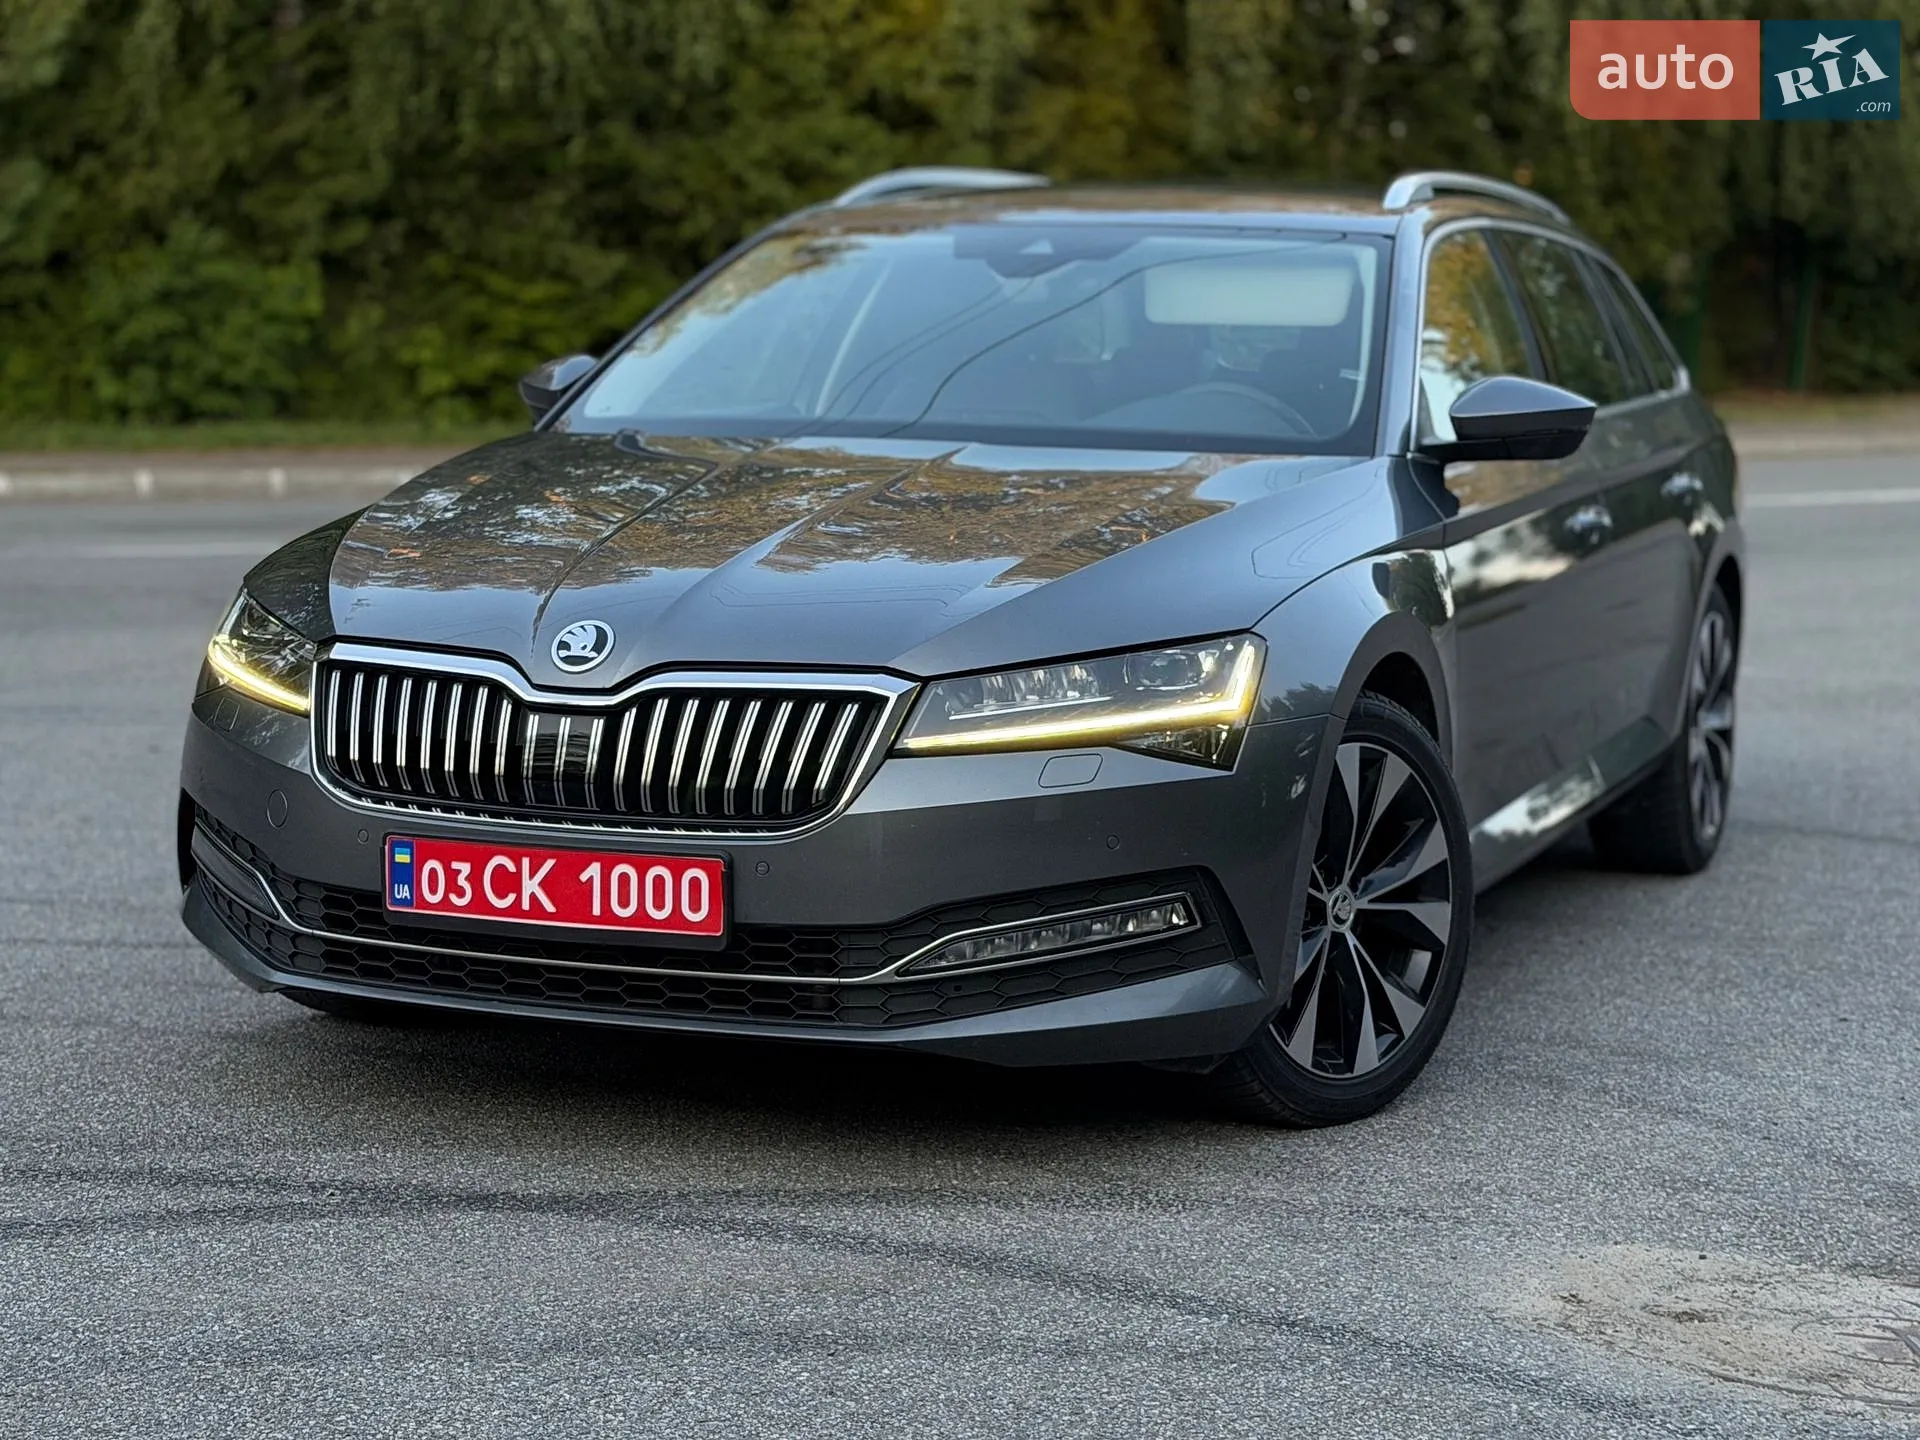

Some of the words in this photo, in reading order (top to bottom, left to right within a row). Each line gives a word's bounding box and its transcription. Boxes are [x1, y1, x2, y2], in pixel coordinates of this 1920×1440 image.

[394, 883, 411, 900] UA
[420, 858, 473, 907] 03
[482, 854, 557, 914] CK
[578, 861, 710, 923] 1000
